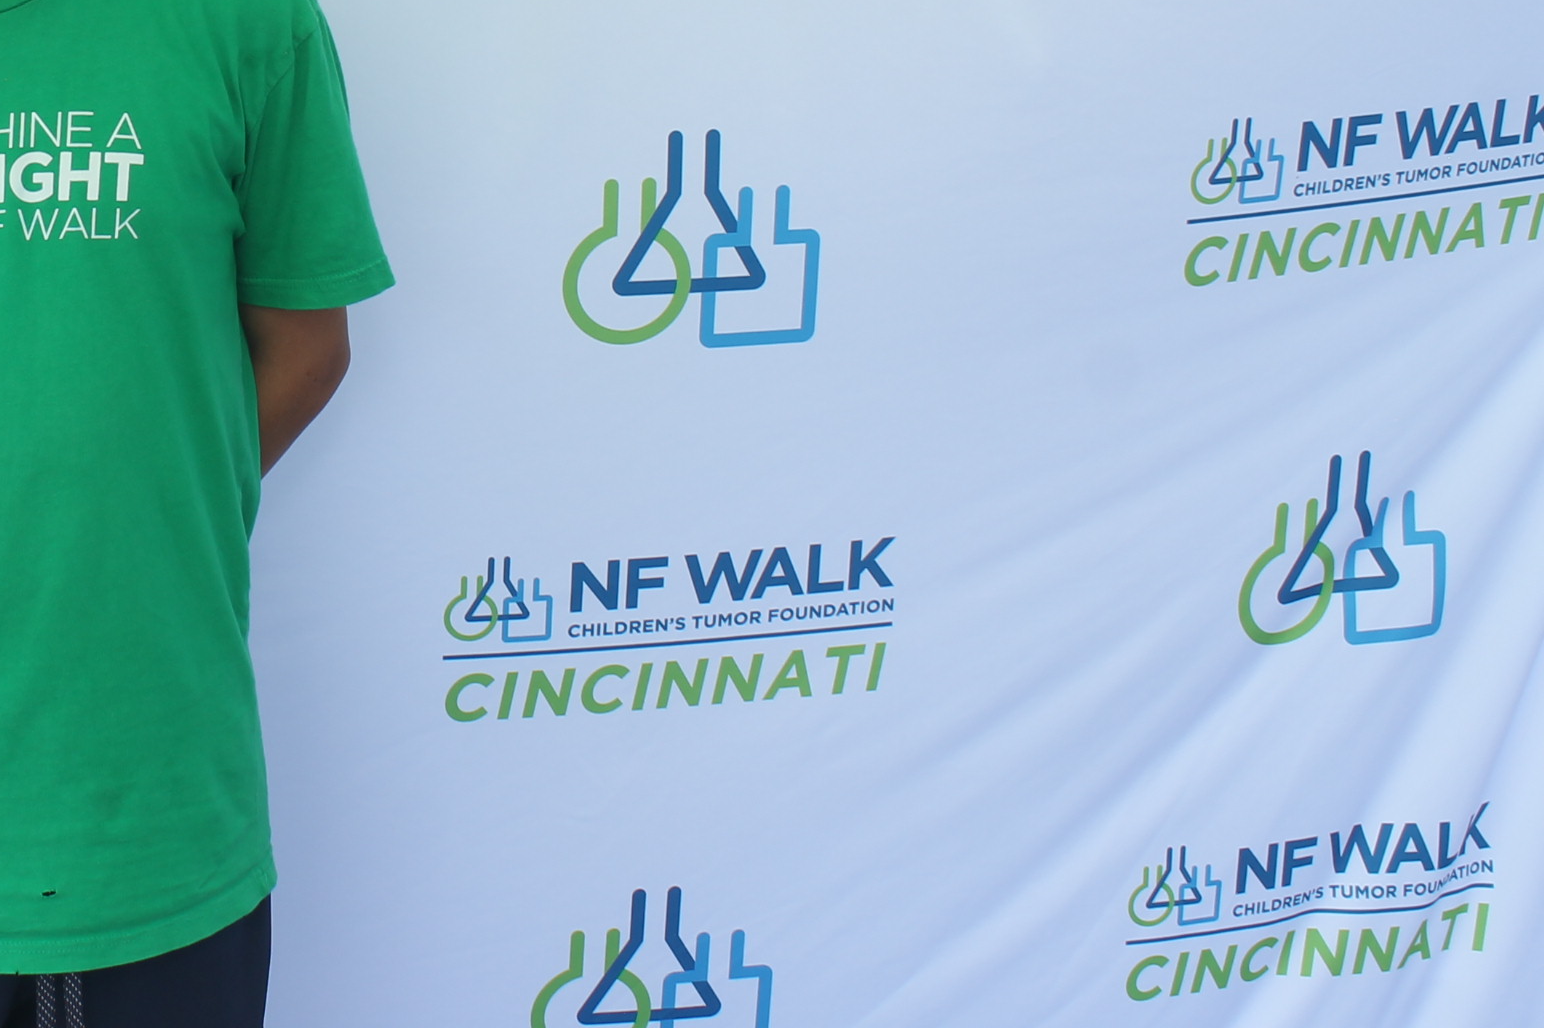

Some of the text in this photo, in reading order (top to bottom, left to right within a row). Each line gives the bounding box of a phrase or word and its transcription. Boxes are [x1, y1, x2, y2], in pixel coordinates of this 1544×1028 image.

[106, 112, 142, 150] A
[1297, 113, 1383, 172] NF
[1293, 173, 1391, 197] CHILDREN'S
[1395, 165, 1451, 185] TUMOR
[17, 207, 141, 241] WALK
[1183, 192, 1544, 287] CINCINNATI
[569, 536, 896, 613] NF WALK
[567, 598, 895, 638] CHILDREN'S TUMOR FOUNDATION
[444, 642, 887, 722] CINCINNATI
[1235, 800, 1492, 894] NF WALK
[1232, 886, 1324, 917] CHILDREN'S
[1329, 884, 1397, 899] TUMOR
[1125, 902, 1490, 1002] CINCINNATI
